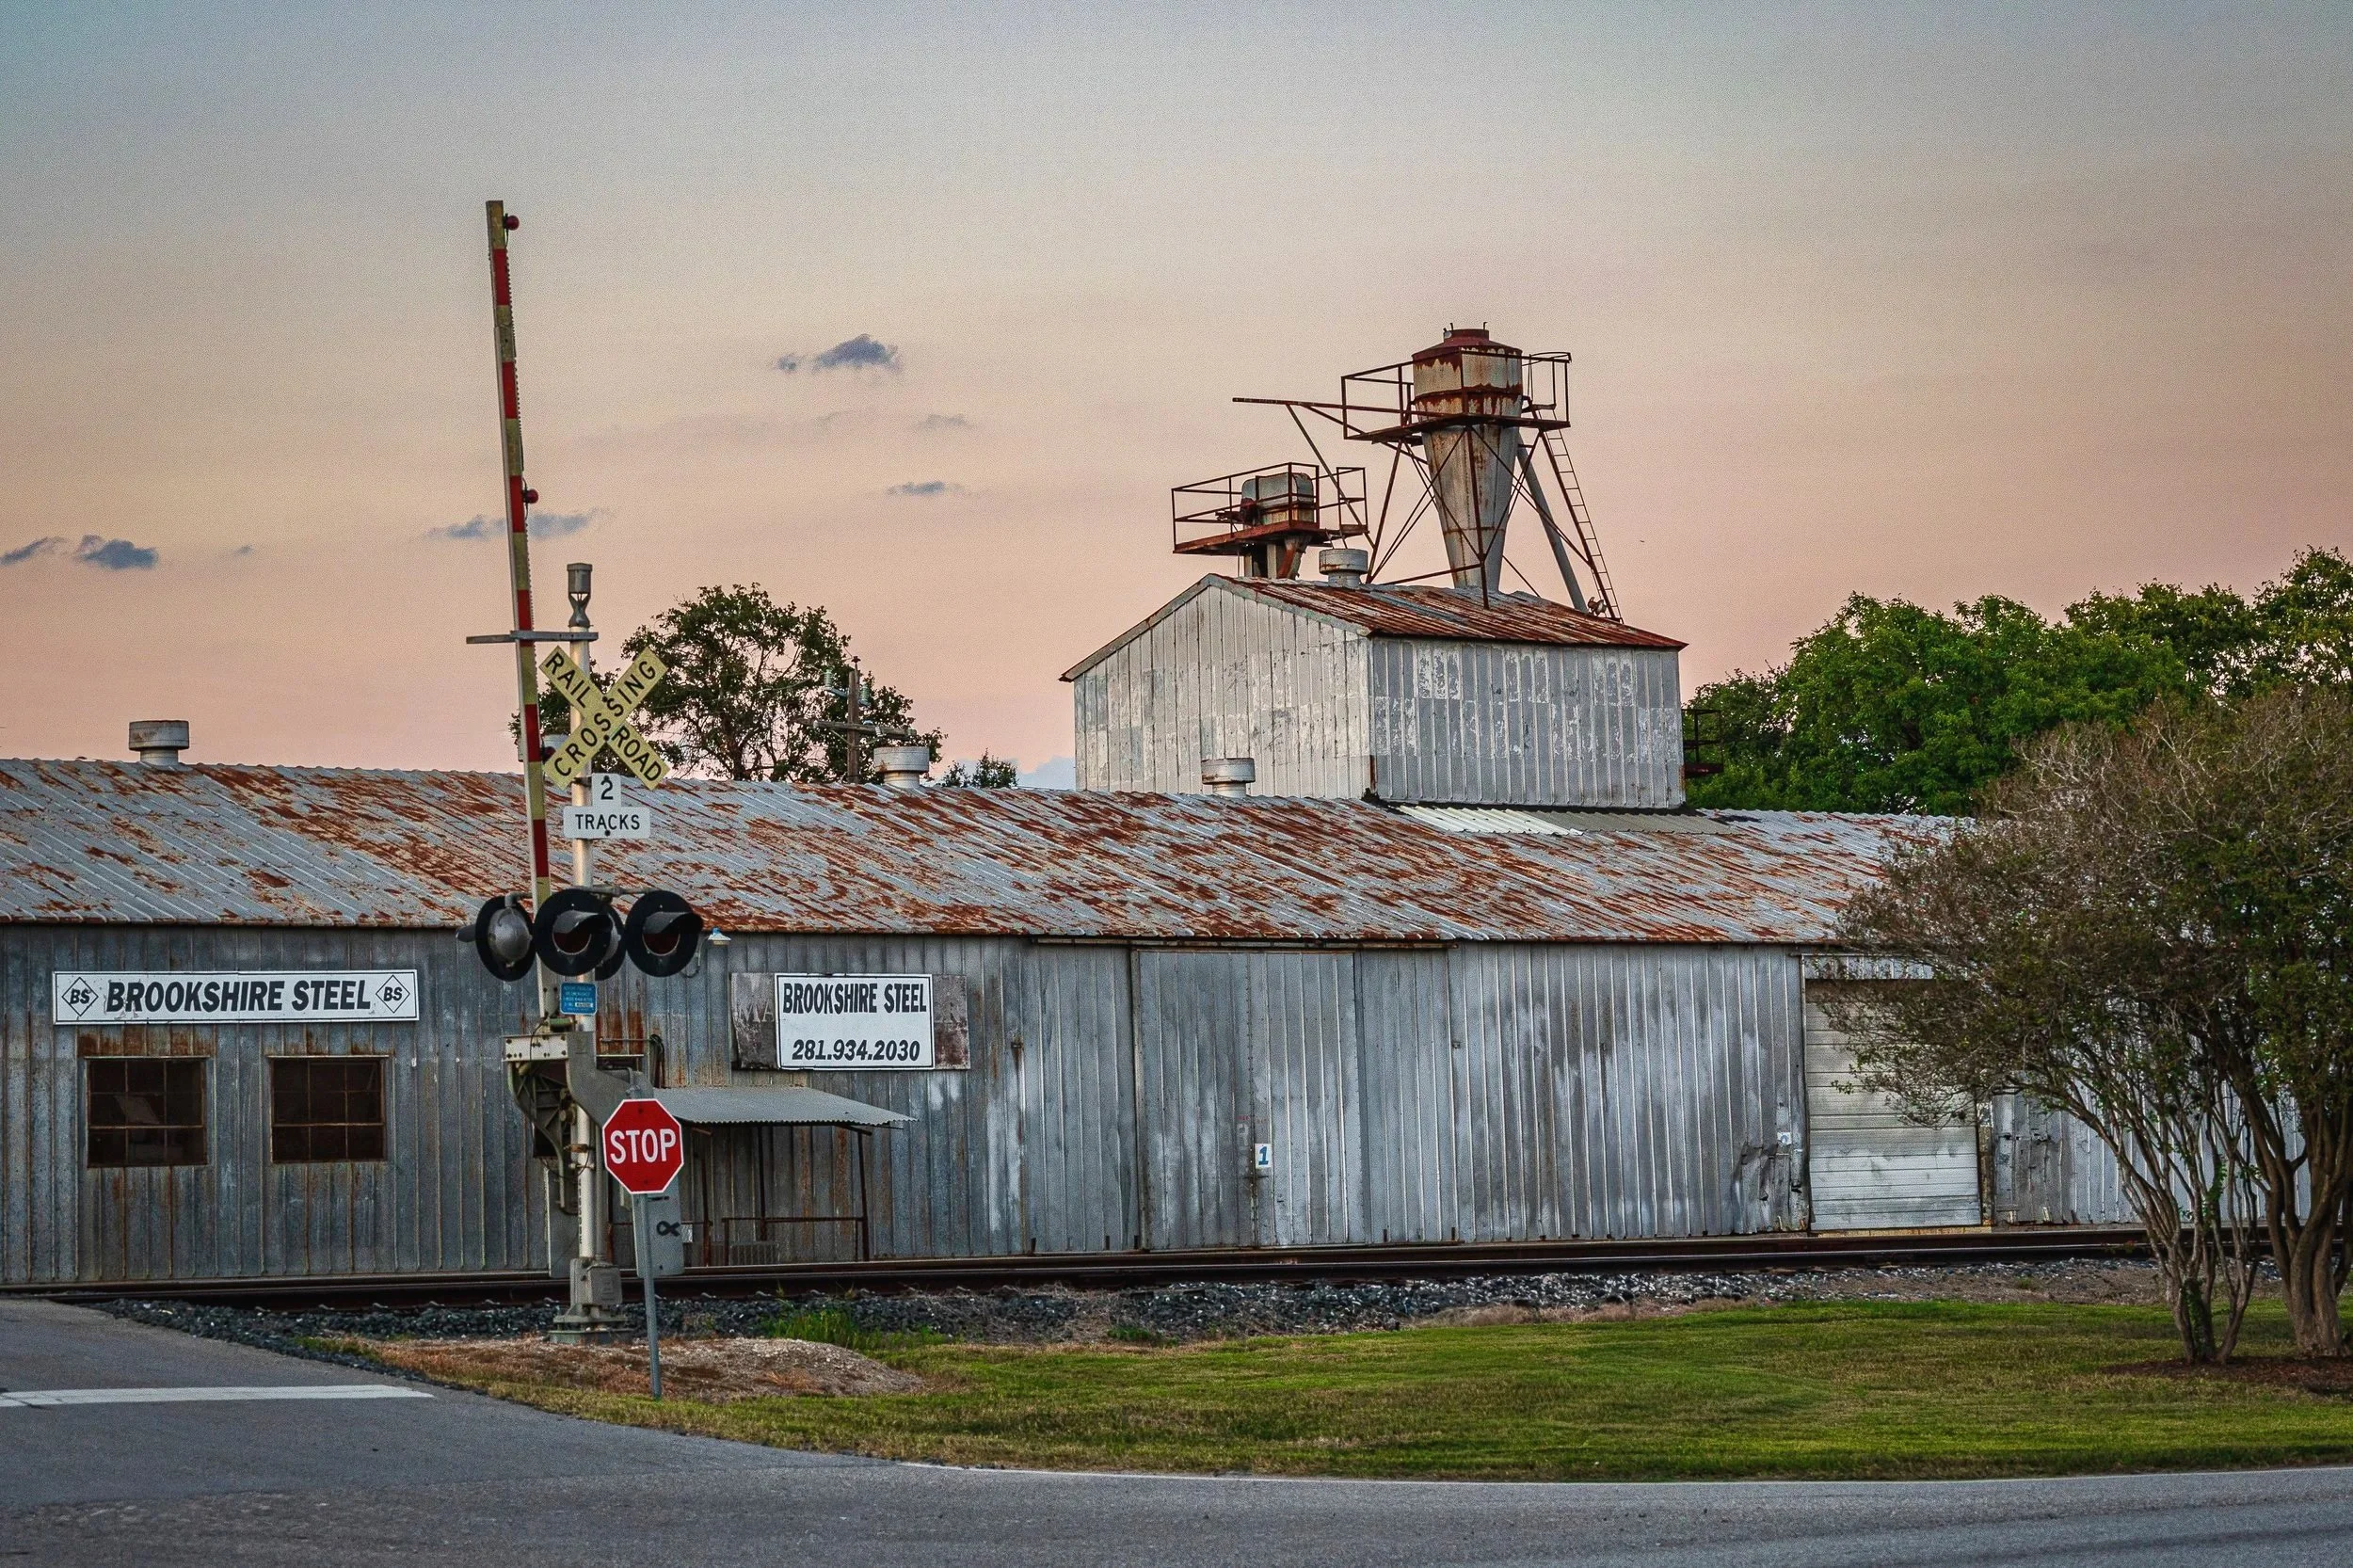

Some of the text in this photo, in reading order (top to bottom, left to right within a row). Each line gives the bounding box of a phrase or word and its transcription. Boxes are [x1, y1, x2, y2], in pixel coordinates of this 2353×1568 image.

[545, 651, 663, 782] RAIL ROAD
[553, 660, 656, 776] CROSSING
[600, 779, 614, 800] 2
[574, 813, 640, 830] TRACKS
[70, 988, 90, 1005] BS
[106, 980, 371, 1012] BROOKSHIRE STEEL
[382, 986, 403, 1002] BS
[782, 983, 878, 1015] BROOKSHIRE
[883, 983, 927, 1014] STEEL
[792, 1038, 920, 1062] 281.934.2030
[610, 1128, 677, 1164] STOP
[1257, 1145, 1269, 1166] 1
